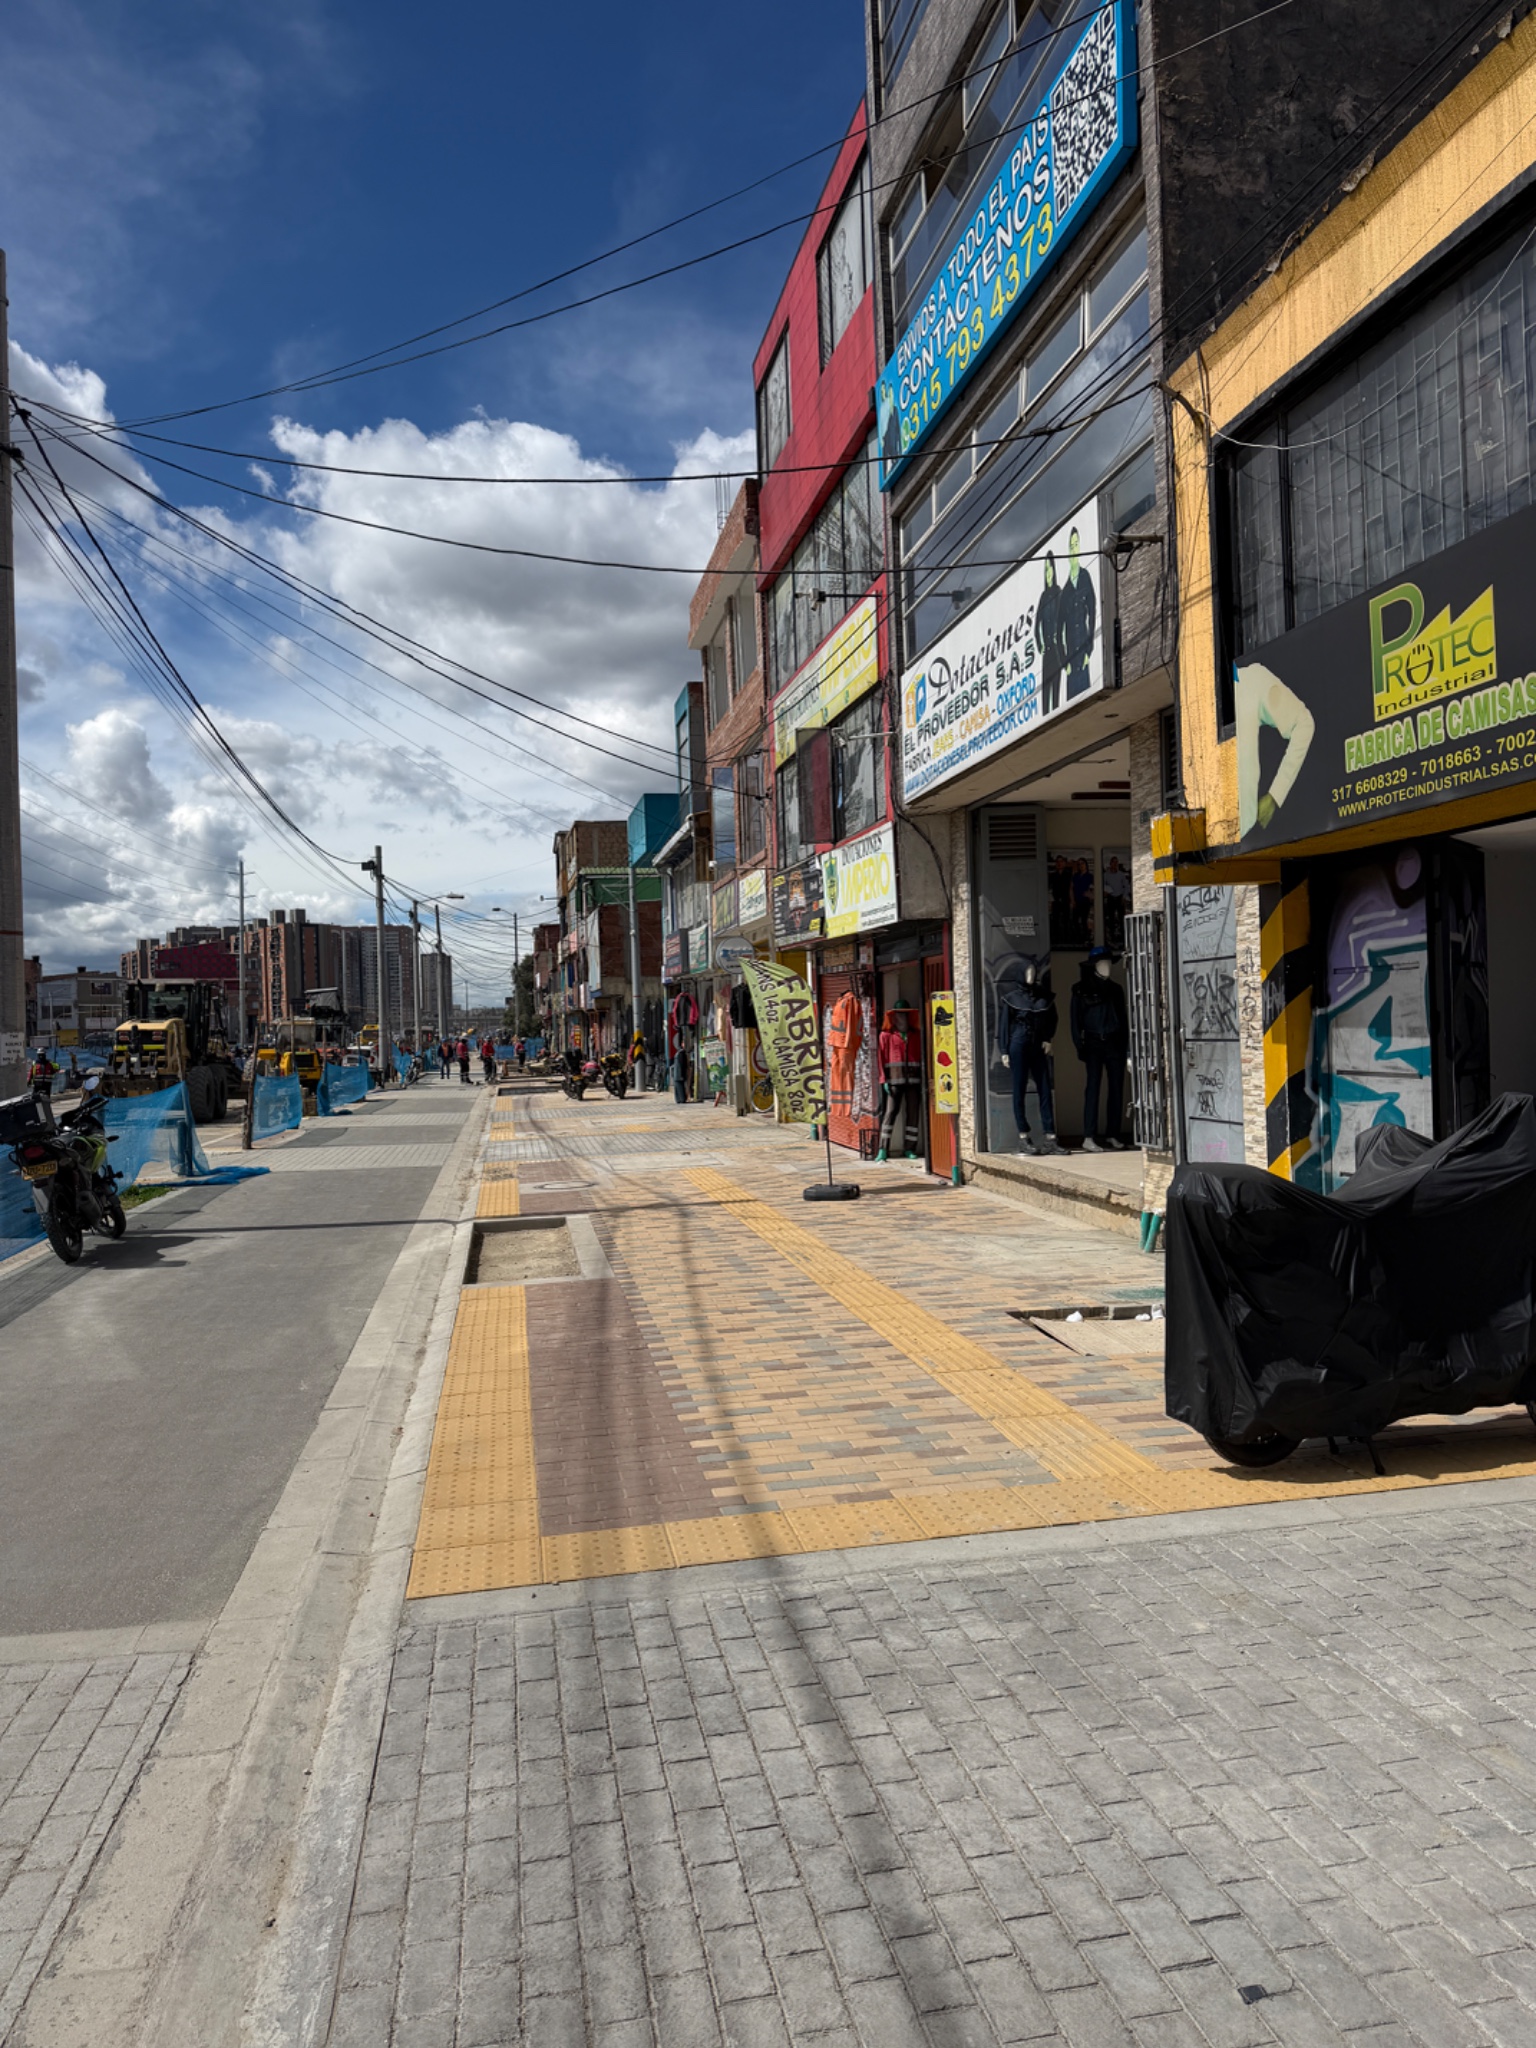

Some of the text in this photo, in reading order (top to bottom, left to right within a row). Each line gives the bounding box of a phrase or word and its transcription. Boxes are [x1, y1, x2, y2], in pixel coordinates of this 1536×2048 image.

[897, 292, 936, 376] ENVIOS
[937, 278, 947, 312] A
[948, 210, 986, 289] TODO
[989, 178, 1008, 224] EL
[899, 153, 1050, 410] CONTACTENOS
[909, 202, 1054, 440] 315 793 4373
[927, 604, 1035, 708] Dotaciones
[996, 672, 1036, 716] OXFORD
[1375, 662, 1495, 718] Industrial
[904, 732, 916, 757] EL
[917, 673, 990, 746] PROVEEDOR
[1345, 671, 1536, 774] FABRICA DE CAMISAS
[1331, 784, 1352, 803] 317
[1355, 767, 1408, 796] 6608329
[1420, 745, 1481, 777] 7018663
[772, 1036, 800, 1088] CAMISA
[777, 974, 827, 1121] FABRICA
